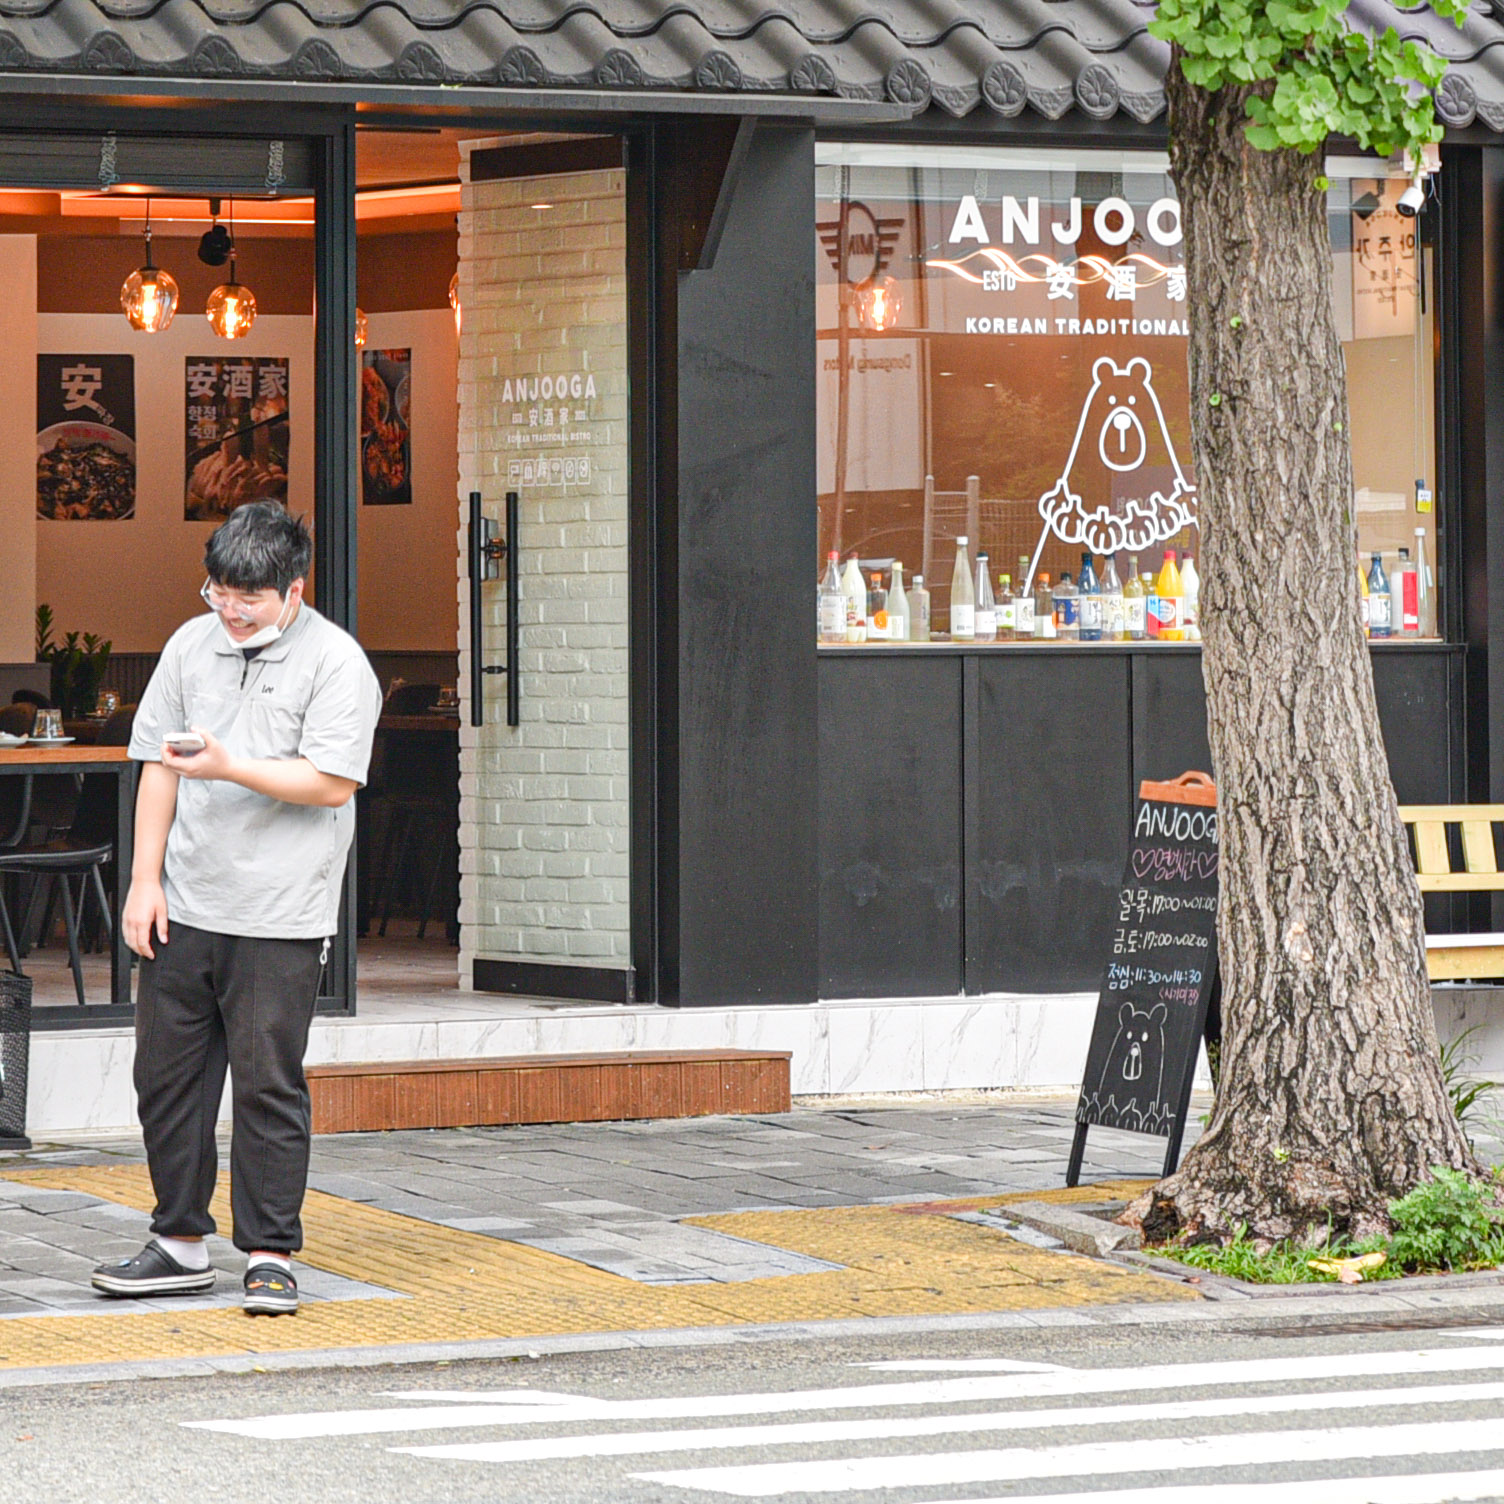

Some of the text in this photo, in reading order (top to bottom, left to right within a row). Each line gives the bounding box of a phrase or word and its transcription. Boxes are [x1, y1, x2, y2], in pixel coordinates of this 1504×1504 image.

[983, 270, 1016, 291] ESTD
[966, 317, 1190, 336] KOREAN TRADITIONAL
[187, 363, 287, 399] 安酒家
[502, 374, 596, 403] ANJOOGA
[1154, 847, 1198, 882] 영업시간
